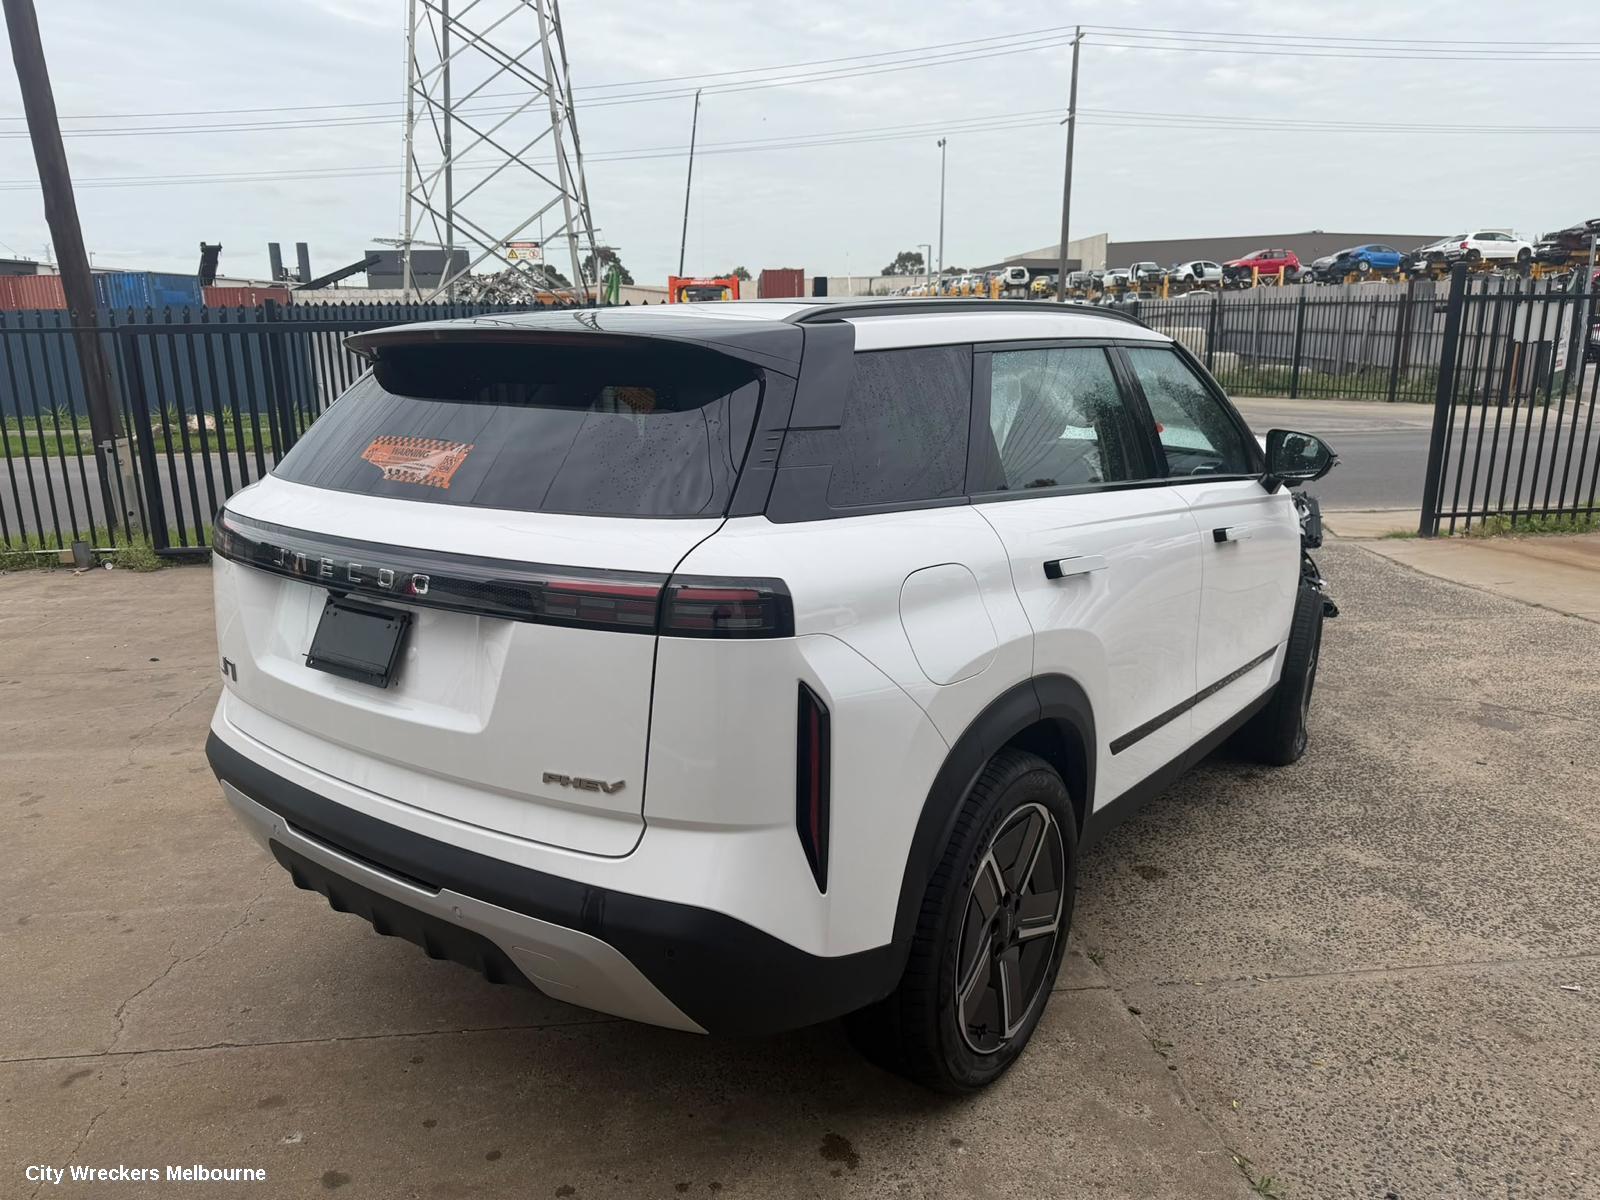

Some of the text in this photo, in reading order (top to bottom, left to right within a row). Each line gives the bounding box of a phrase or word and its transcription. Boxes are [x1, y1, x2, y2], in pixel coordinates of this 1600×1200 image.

[391, 447, 431, 458] WARNING
[273, 549, 431, 595] JAECOO
[542, 772, 626, 793] PHEV
